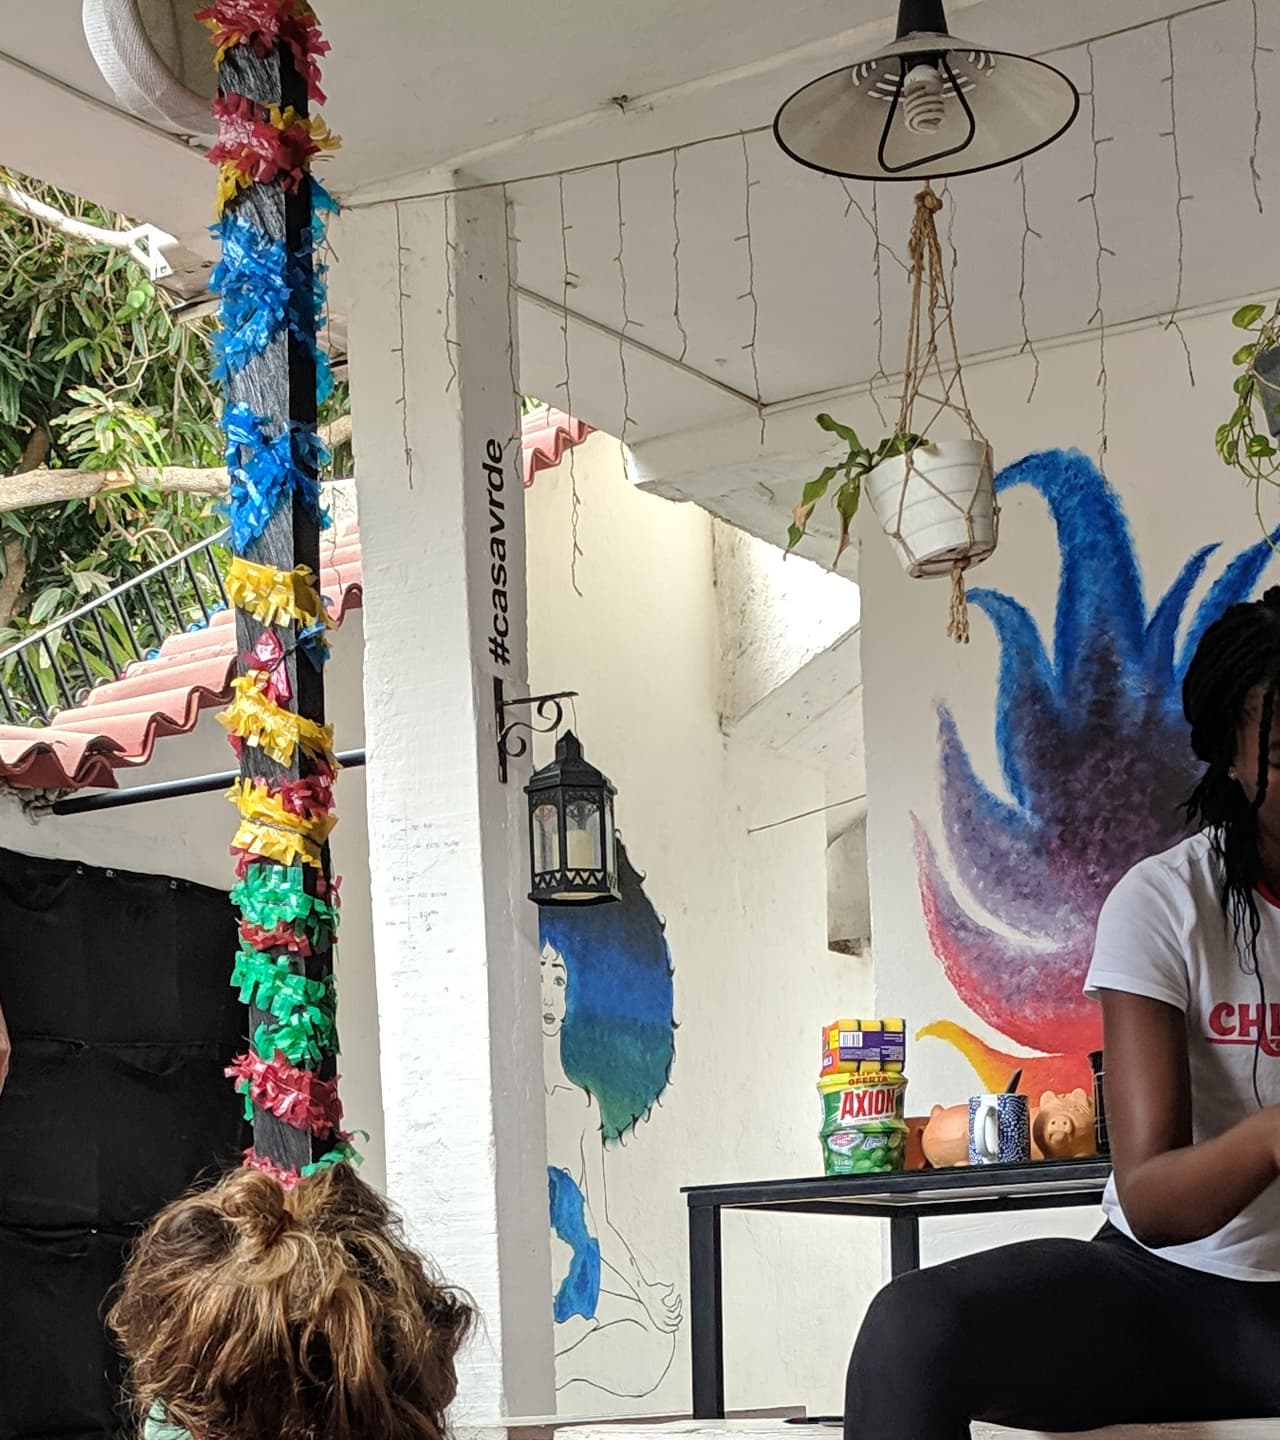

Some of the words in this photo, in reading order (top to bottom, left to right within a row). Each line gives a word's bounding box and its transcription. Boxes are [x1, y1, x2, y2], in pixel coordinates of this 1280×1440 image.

[482, 438, 511, 666] #casavrde
[848, 1076, 888, 1086] OFERTA
[840, 1088, 896, 1120] AXION
